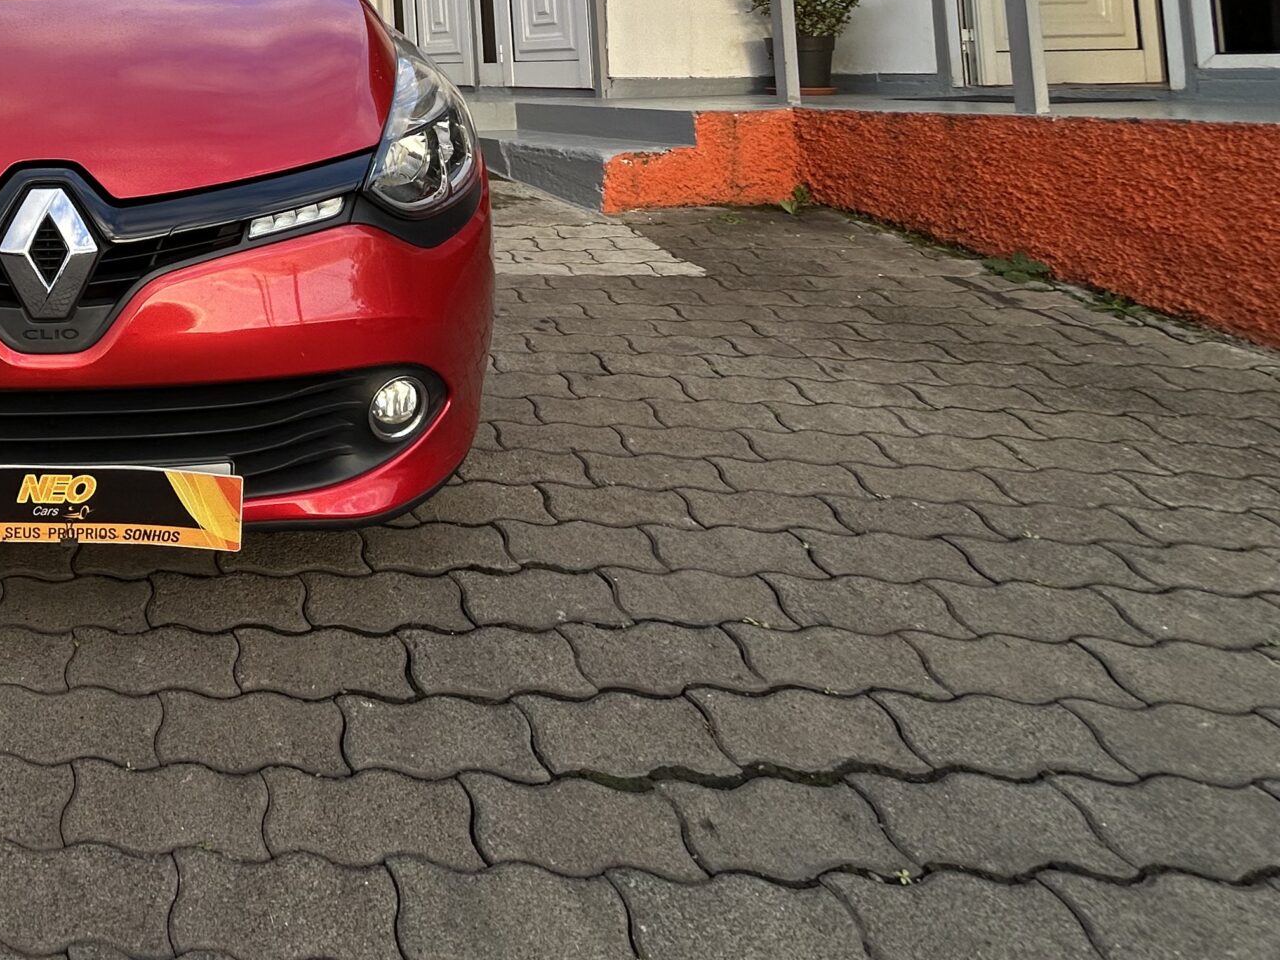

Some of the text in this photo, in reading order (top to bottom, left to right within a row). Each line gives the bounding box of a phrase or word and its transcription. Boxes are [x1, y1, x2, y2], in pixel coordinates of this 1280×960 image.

[22, 328, 80, 340] CLIO
[16, 474, 98, 504] NEO
[32, 505, 60, 517] Cars
[4, 526, 41, 540] SEUS
[122, 527, 181, 543] SONHOS
